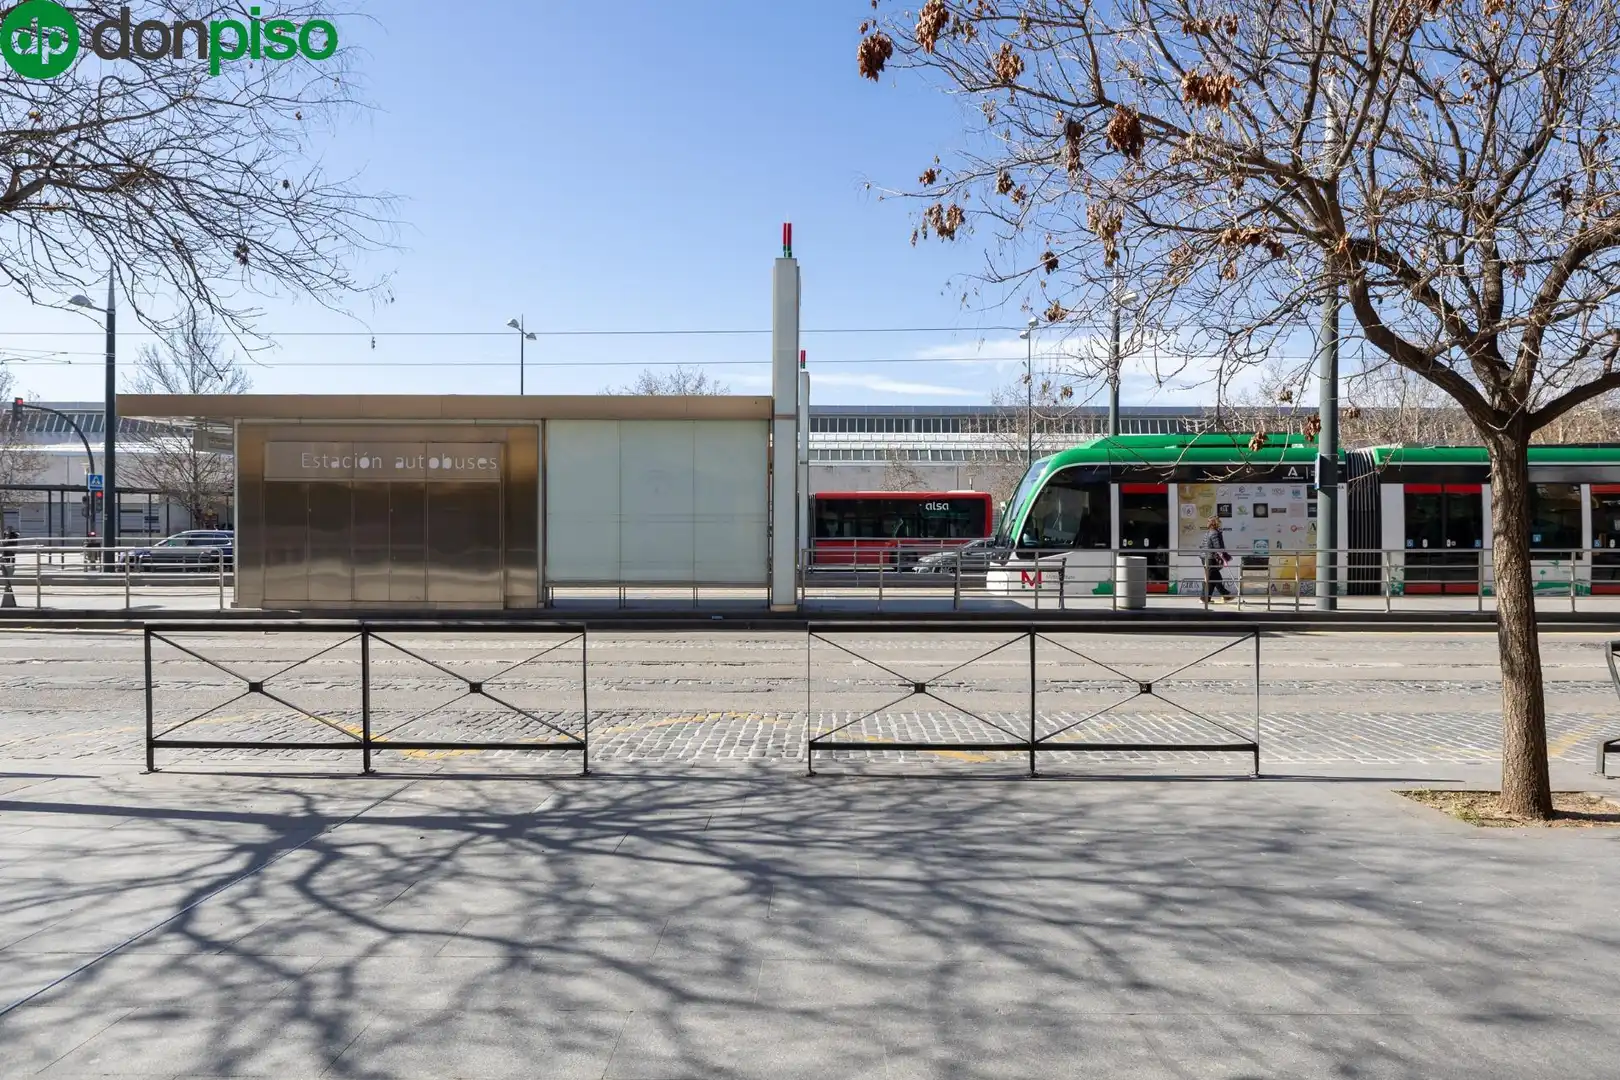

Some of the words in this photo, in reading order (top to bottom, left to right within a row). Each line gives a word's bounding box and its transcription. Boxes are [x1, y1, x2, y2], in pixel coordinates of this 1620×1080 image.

[301, 452, 382, 469] Estación
[395, 453, 498, 469] autobuses
[925, 502, 949, 511] alsa
